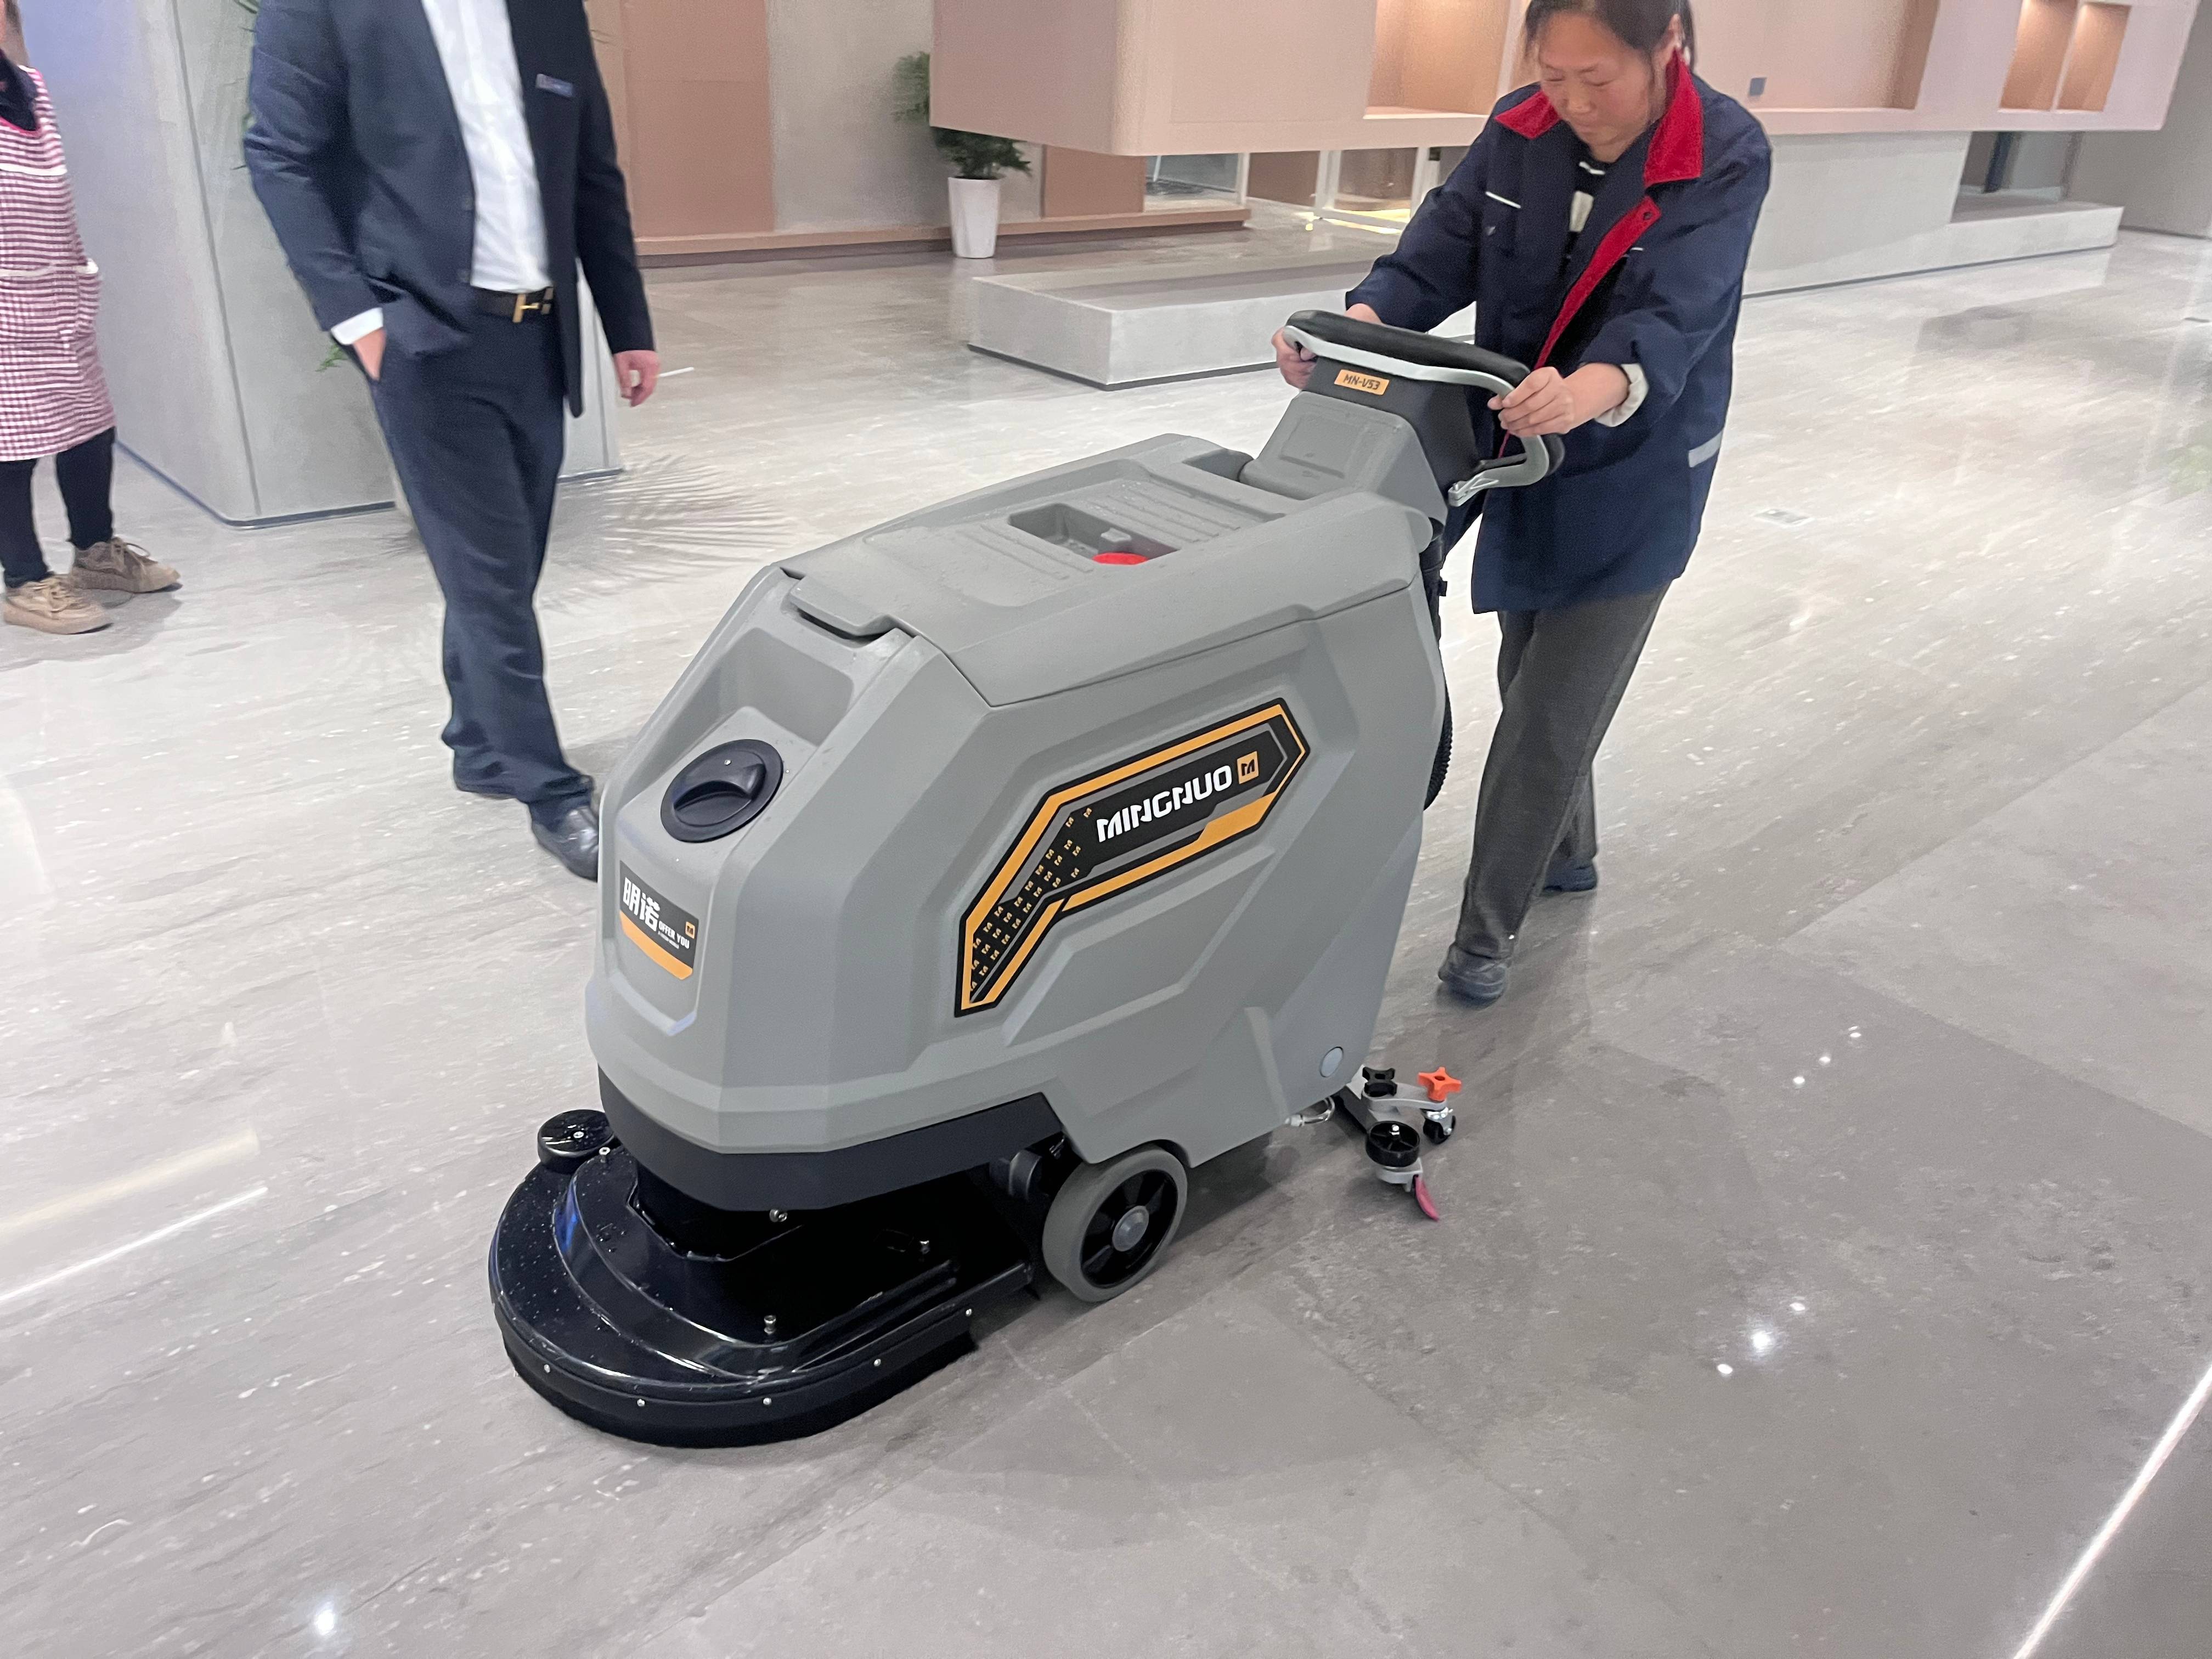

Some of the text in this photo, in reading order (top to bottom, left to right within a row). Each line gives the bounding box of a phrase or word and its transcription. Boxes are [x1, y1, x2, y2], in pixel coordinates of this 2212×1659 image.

[1344, 374, 1381, 390] MN-V53
[1096, 765, 1233, 843] MINGNUO
[623, 877, 661, 932] 明诺
[658, 921, 675, 940] OFFER
[676, 933, 690, 949] YOU
